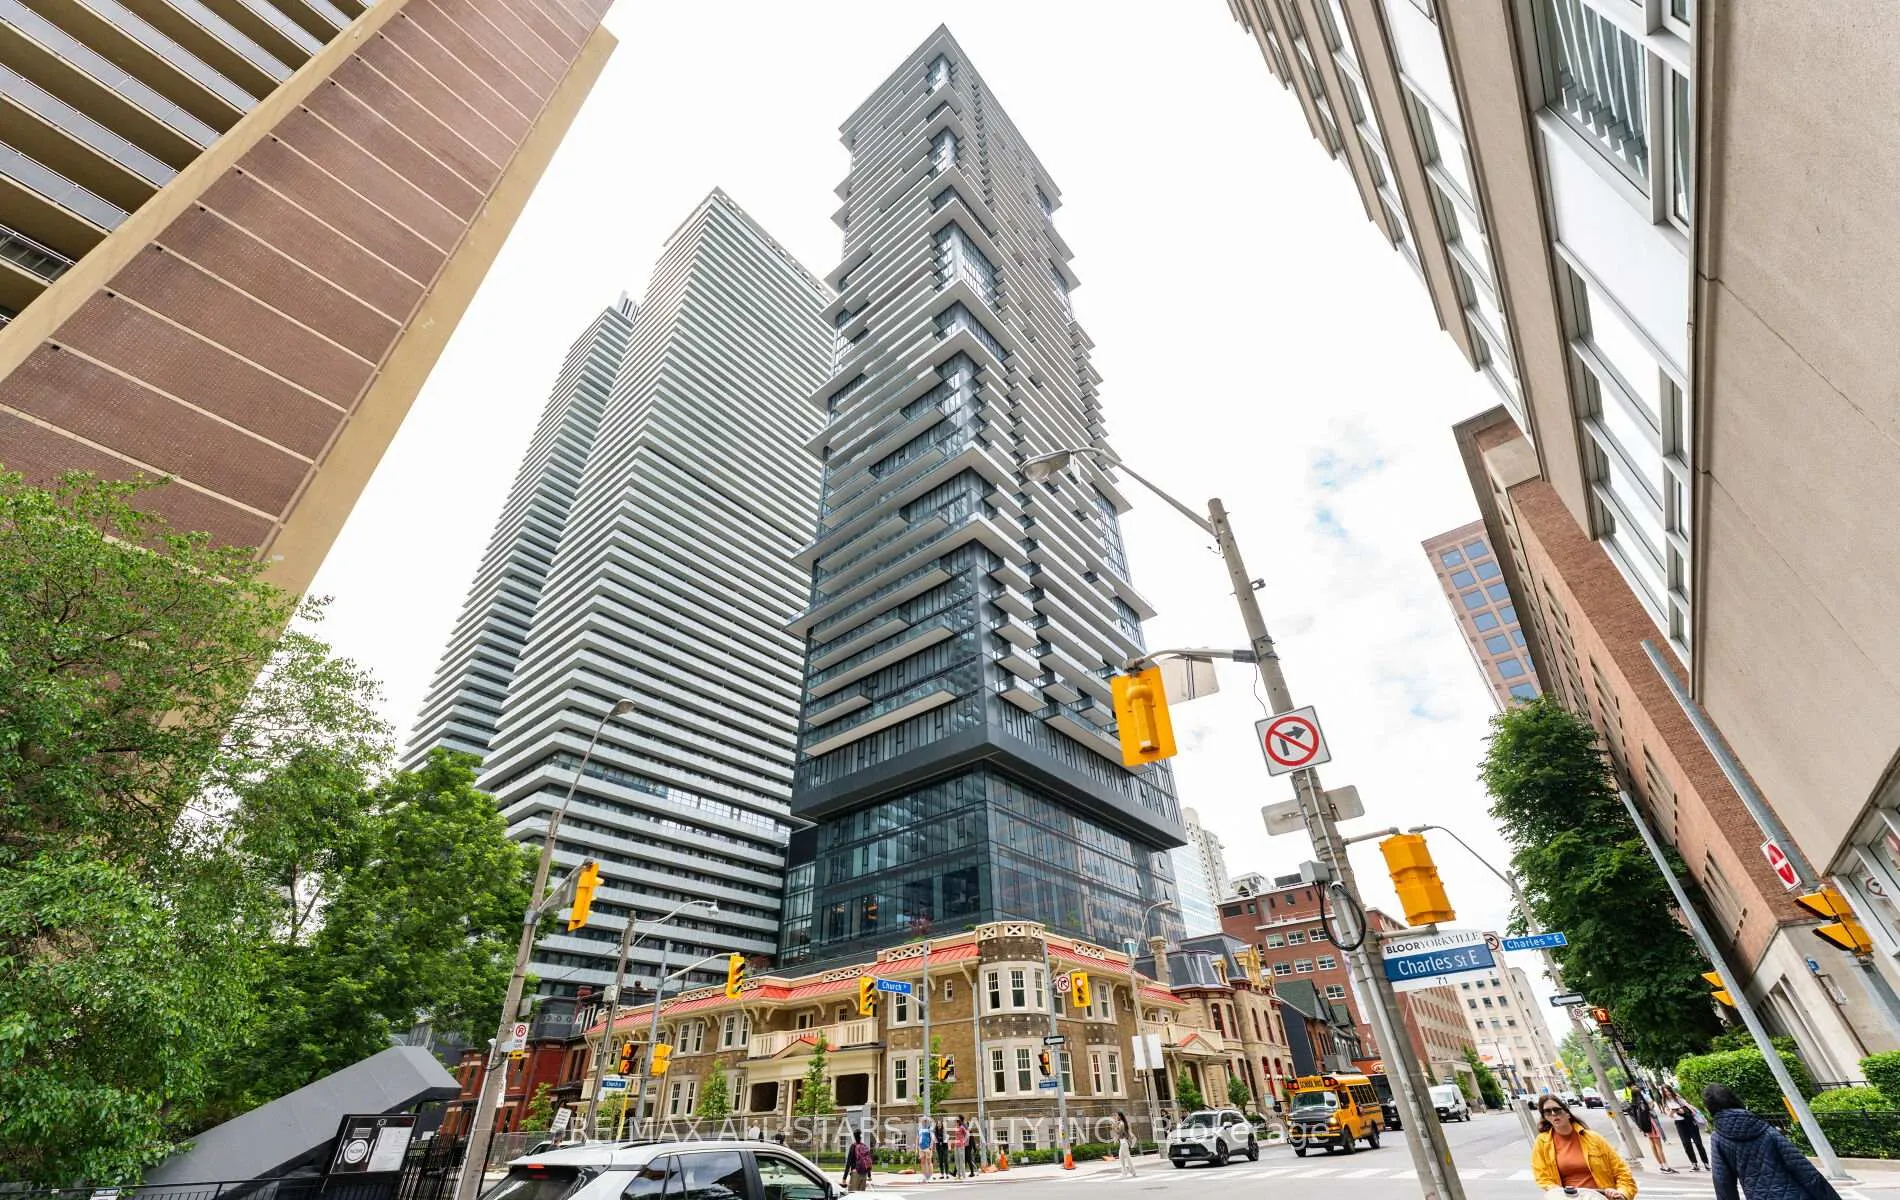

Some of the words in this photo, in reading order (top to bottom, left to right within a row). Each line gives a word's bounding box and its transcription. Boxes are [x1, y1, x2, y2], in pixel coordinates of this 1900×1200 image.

[1506, 938, 1546, 949] Charles
[1554, 934, 1562, 944] E
[1398, 956, 1453, 976] Charles
[1454, 955, 1467, 968] St
[1468, 949, 1480, 965] E
[882, 981, 902, 991] Church
[1434, 976, 1449, 985] 71
